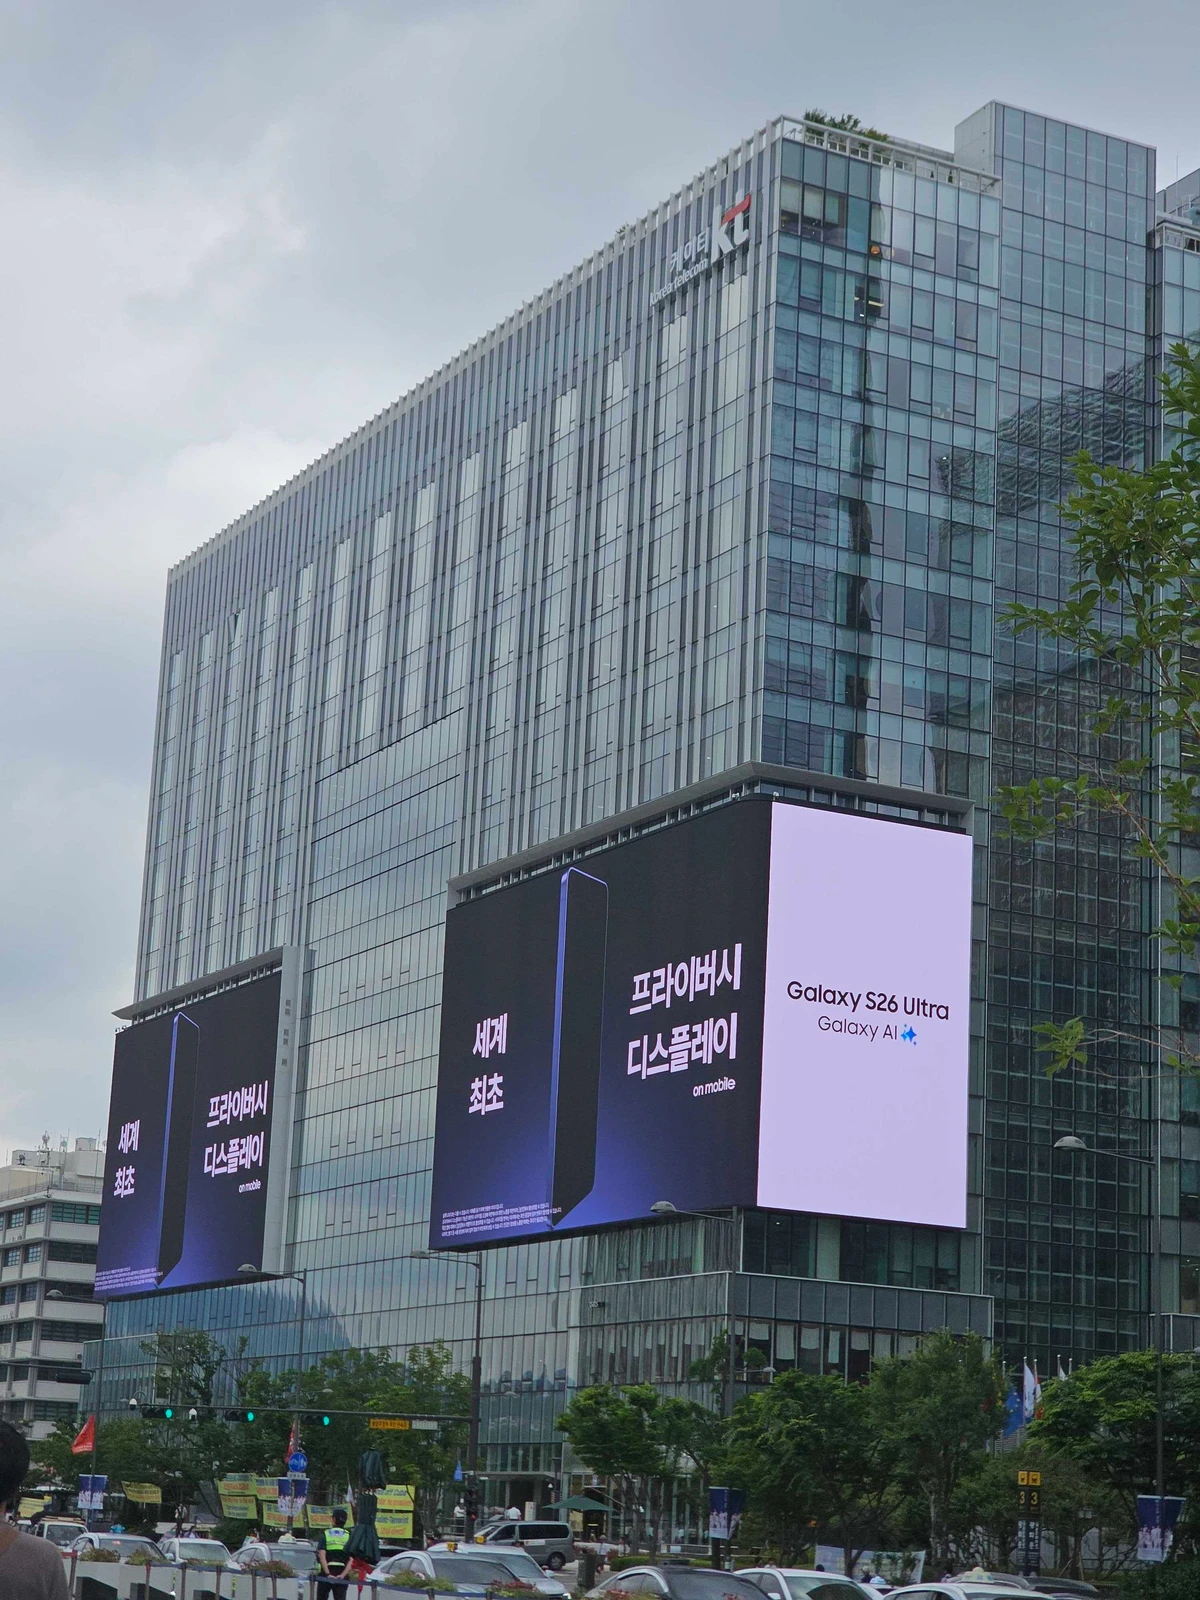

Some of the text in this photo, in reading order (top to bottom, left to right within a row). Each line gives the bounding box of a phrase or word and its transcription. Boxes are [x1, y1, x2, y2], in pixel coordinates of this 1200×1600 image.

[629, 942, 742, 1015] 프라이버시
[787, 981, 950, 1020] Galaxy S26 Ultra
[472, 1012, 508, 1058] 세계
[627, 1012, 738, 1079] 디스플레이
[817, 1015, 898, 1042] Galaxy AI
[206, 1080, 268, 1128] 프라이버시
[468, 1073, 504, 1116] 최초
[692, 1076, 736, 1097] on mobile
[118, 1119, 140, 1154] 세계
[203, 1131, 265, 1178] 디스플레이
[113, 1166, 136, 1198] 최초
[1020, 1491, 1026, 1504] 3
[1030, 1492, 1038, 1505] 3
